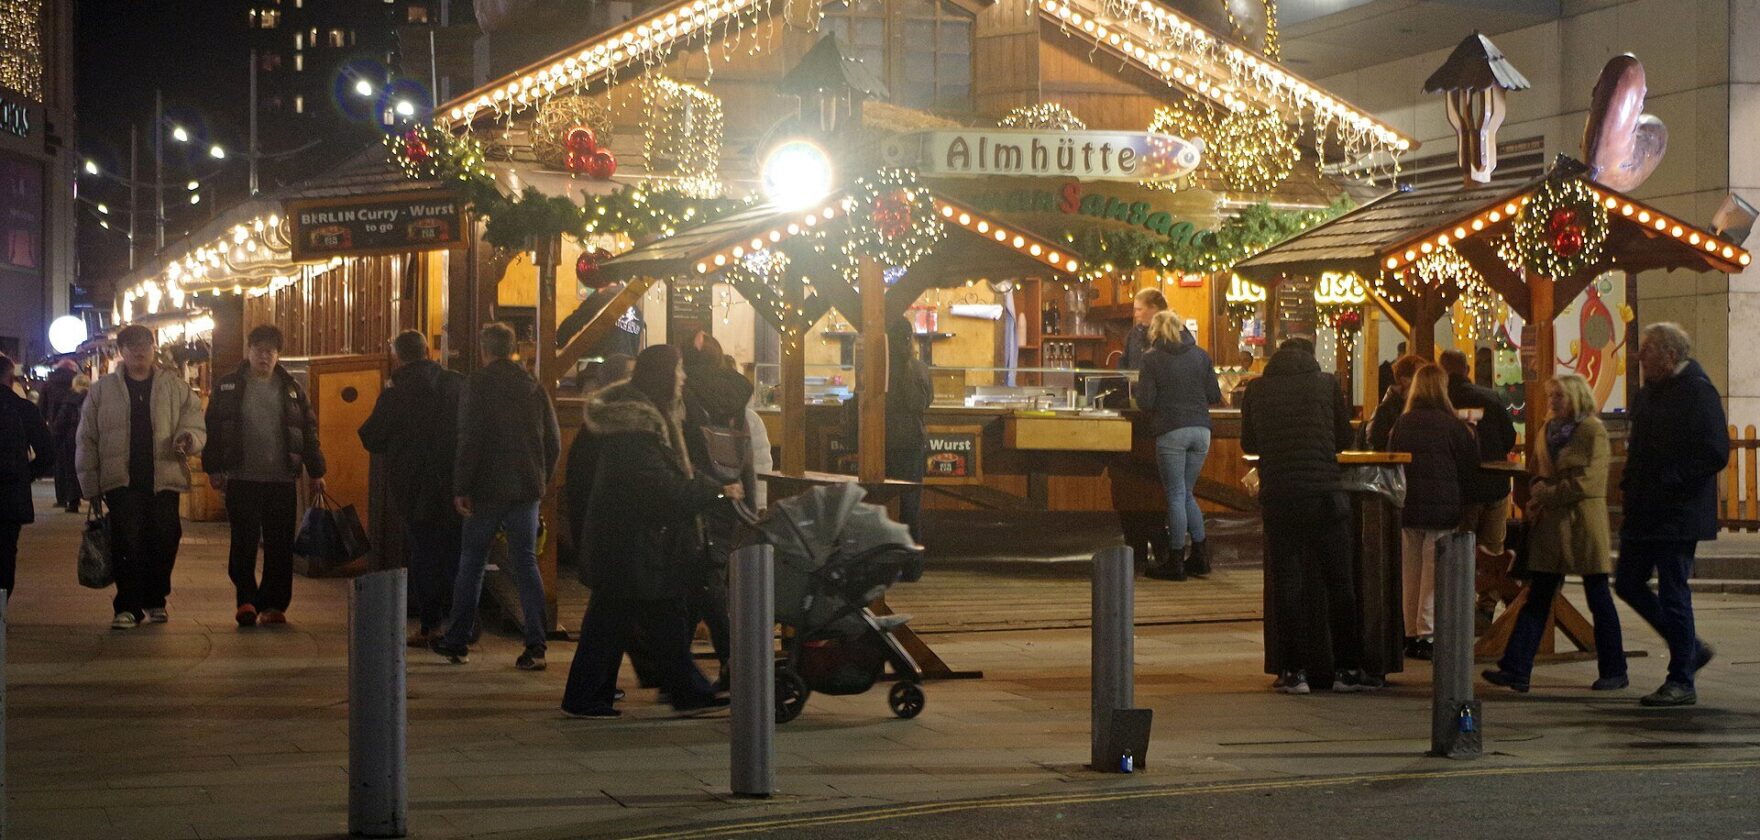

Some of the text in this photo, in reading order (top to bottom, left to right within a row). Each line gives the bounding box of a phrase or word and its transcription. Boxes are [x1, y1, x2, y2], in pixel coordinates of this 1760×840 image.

[946, 136, 1136, 173] Almhütte
[301, 210, 356, 225] BERLIN
[357, 208, 398, 222] Curry
[409, 203, 455, 217] Wurst
[365, 223, 393, 234] to go
[929, 439, 971, 451] Wurst
